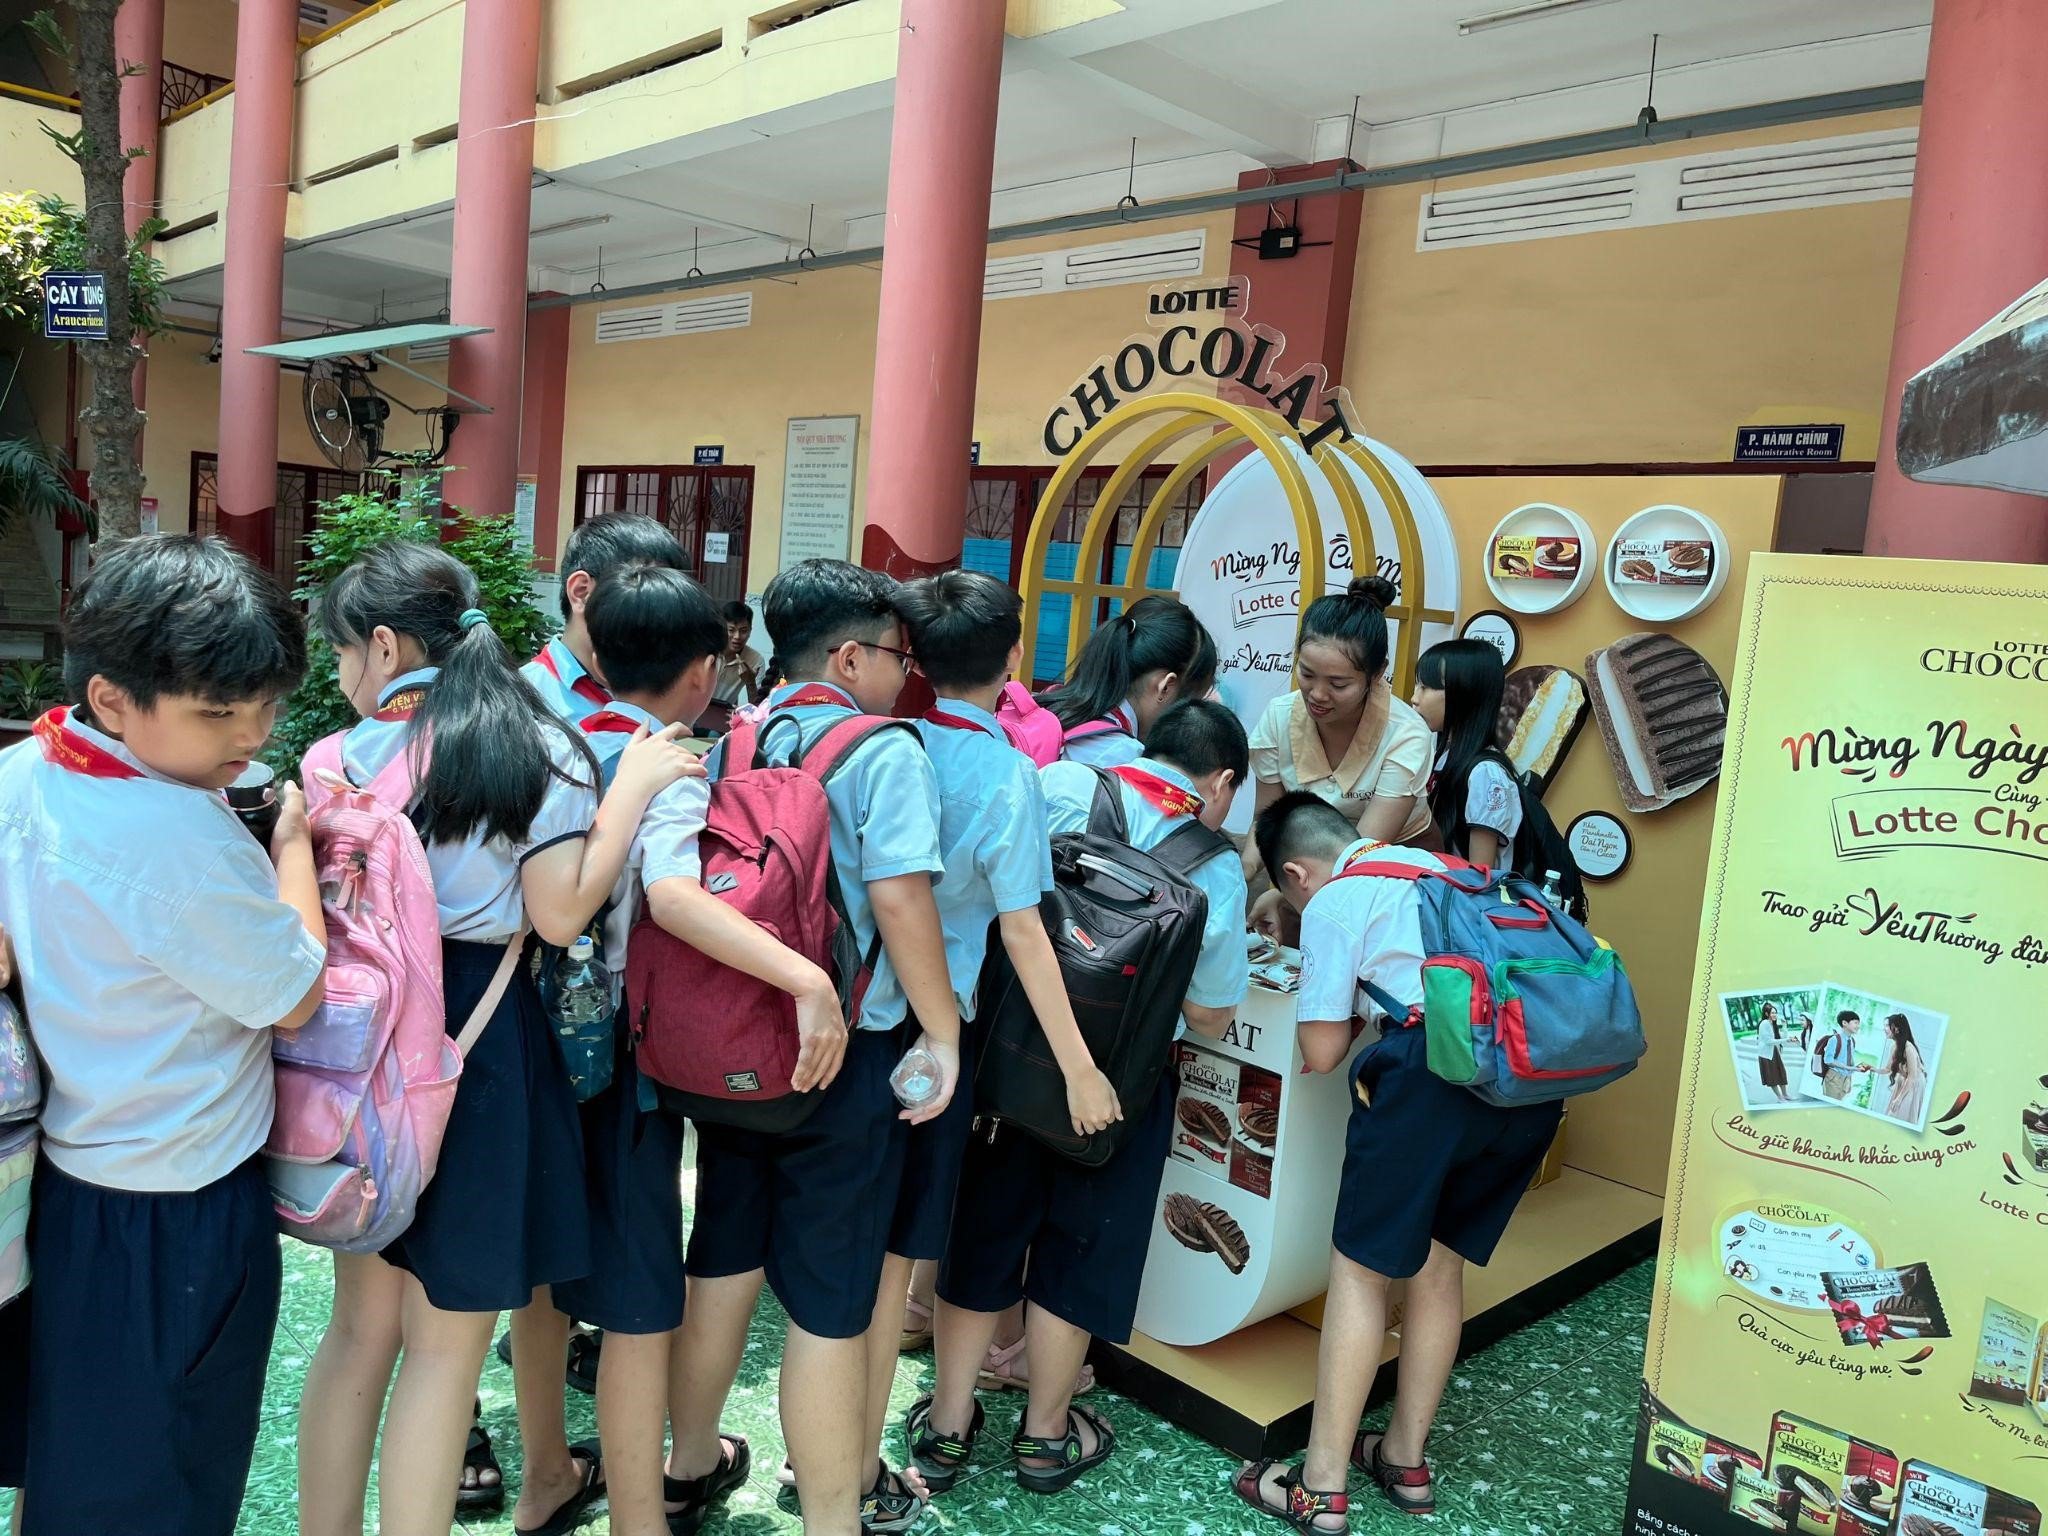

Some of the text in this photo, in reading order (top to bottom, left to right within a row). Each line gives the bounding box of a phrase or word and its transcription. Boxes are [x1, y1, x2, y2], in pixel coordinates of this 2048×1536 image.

[49, 281, 103, 305] CÂY TÙNG
[1150, 286, 1239, 314] LOTTE
[1044, 325, 1355, 457] CHOCOLAT
[1742, 447, 1832, 457] Administrative Room
[1749, 430, 1829, 446] P. HÀNH CHÍNH
[1211, 551, 1268, 580] Mừng
[1239, 593, 1284, 615] Lotte
[1781, 726, 1920, 779] Mừng
[1994, 783, 2042, 812] Cùng
[1849, 806, 1957, 837] Lotte
[1761, 890, 1808, 917] Trao
[1812, 904, 1849, 932] gửi
[1182, 1062, 1237, 1089] CHOCOLAT
[1759, 1134, 1789, 1150] giữ
[1793, 1137, 1854, 1163] khoảnh
[1859, 1145, 1900, 1164] khắc
[1904, 1147, 1944, 1167] cùng
[1948, 1139, 1976, 1155] con
[1757, 1205, 1830, 1223] CHOCOLAT
[1979, 1191, 2029, 1220] Lotte
[1833, 1273, 1896, 1287] CHOCOLAT
[1738, 1313, 1892, 1381] Quà cực yêu tặng mẹ
[1978, 1403, 2006, 1428] Trao
[2008, 1423, 2031, 1444] Mẹ
[1777, 1431, 1845, 1462] CHOCOLAT
[1908, 1481, 1982, 1514] CHOCOLAT
